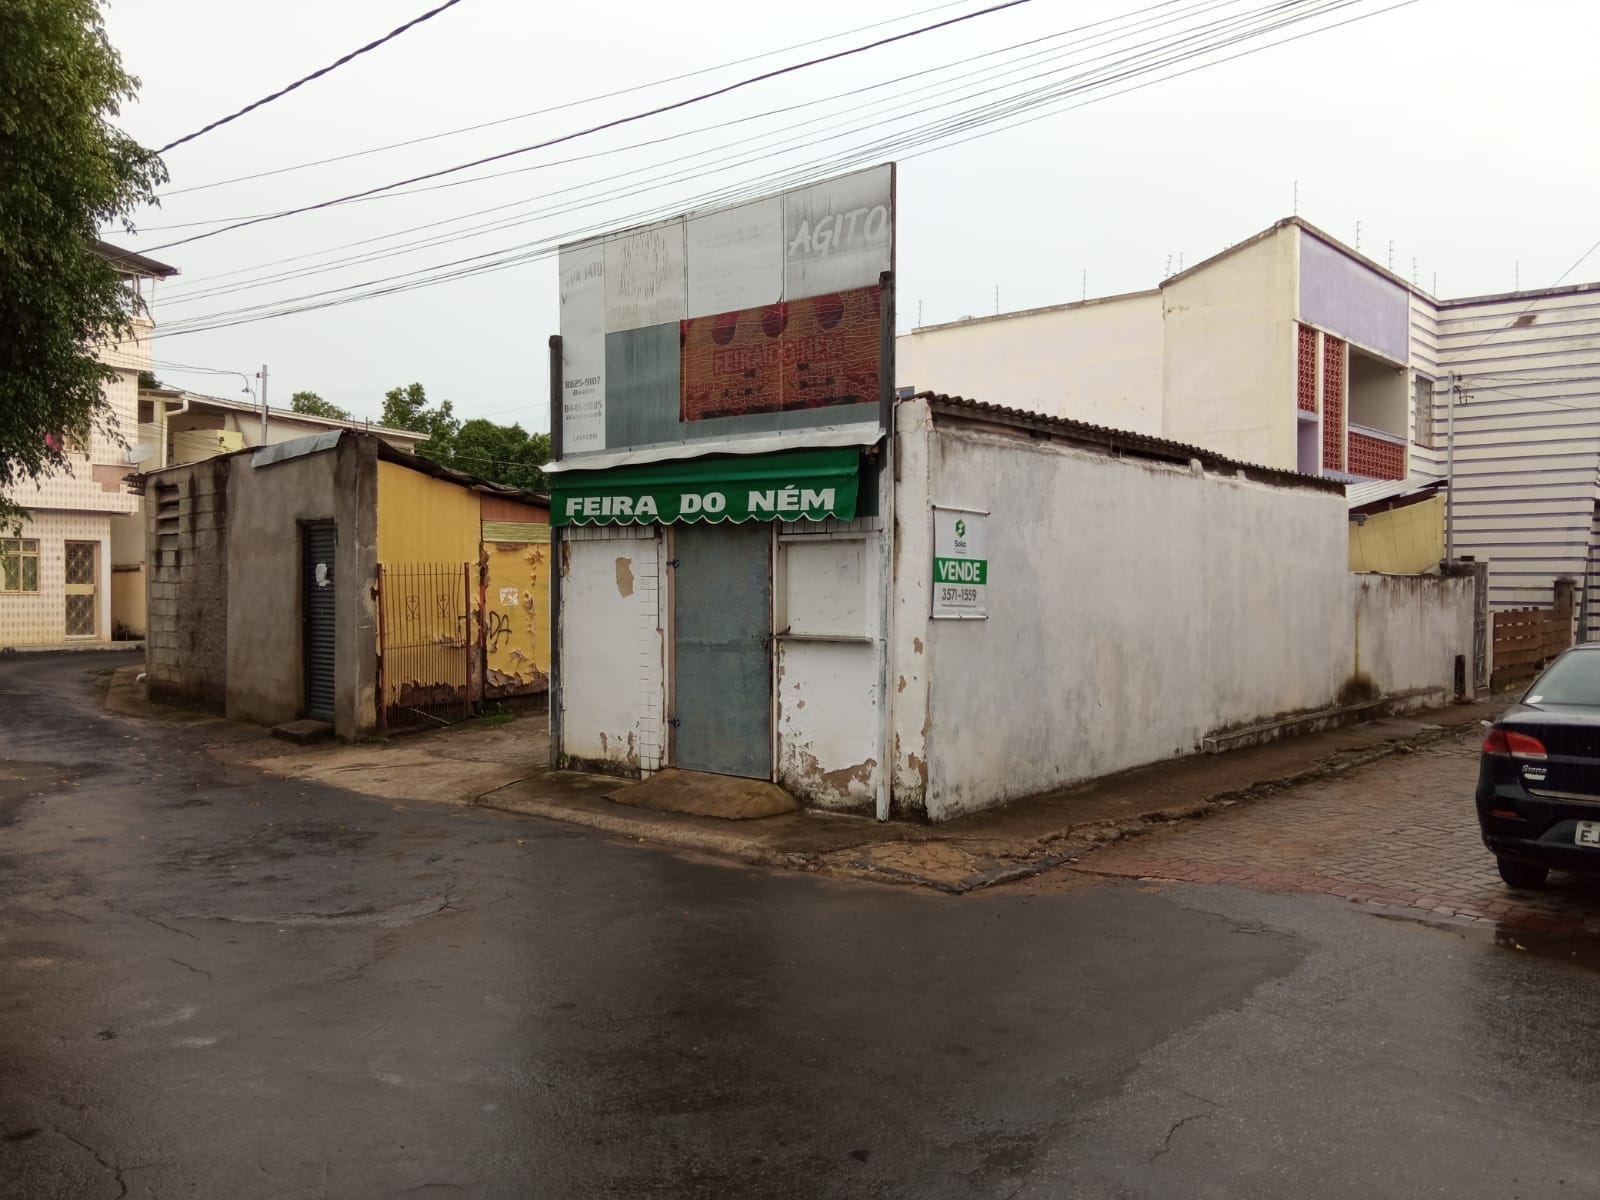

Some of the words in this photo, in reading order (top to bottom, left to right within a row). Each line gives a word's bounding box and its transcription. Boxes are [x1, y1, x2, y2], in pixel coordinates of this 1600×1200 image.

[788, 203, 888, 259] AGITO
[565, 495, 658, 516] FEIRA
[679, 491, 726, 514] DO
[747, 484, 836, 512] NÉM
[938, 560, 981, 582] VENDE
[941, 587, 977, 602] 3571-1559
